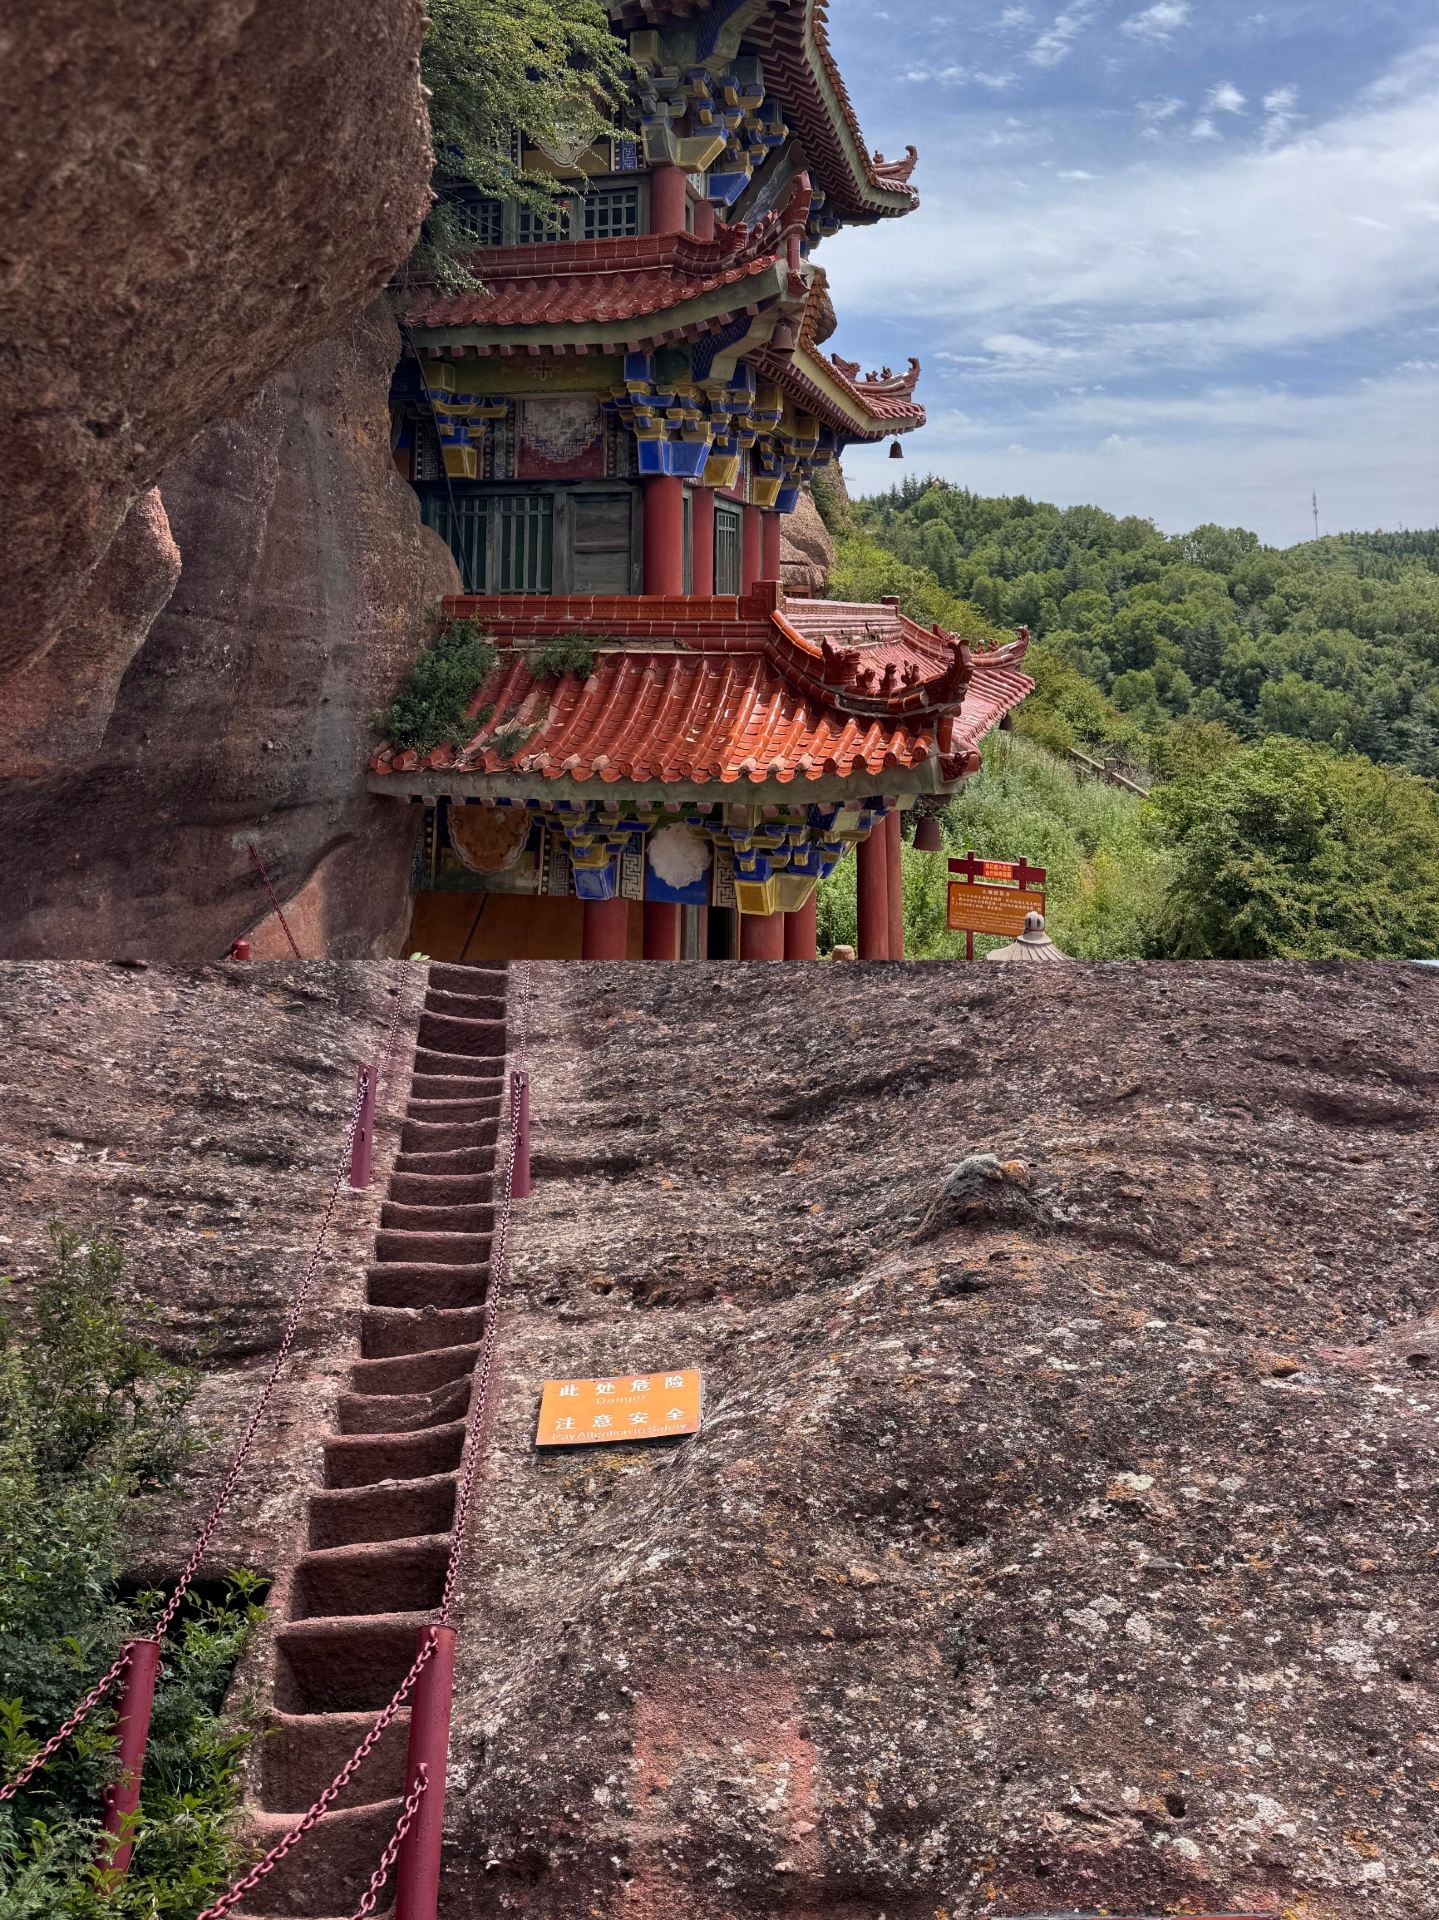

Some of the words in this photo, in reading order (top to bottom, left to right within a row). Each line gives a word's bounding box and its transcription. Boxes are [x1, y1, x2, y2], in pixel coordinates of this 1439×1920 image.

[559, 1376, 686, 1396] 此处危险
[596, 1394, 647, 1404] Danger
[555, 1408, 686, 1430] 注意安全
[552, 1431, 575, 1440] Pay
[577, 1428, 632, 1439] Attention
[634, 1427, 646, 1435] to
[647, 1424, 687, 1434] Safety
